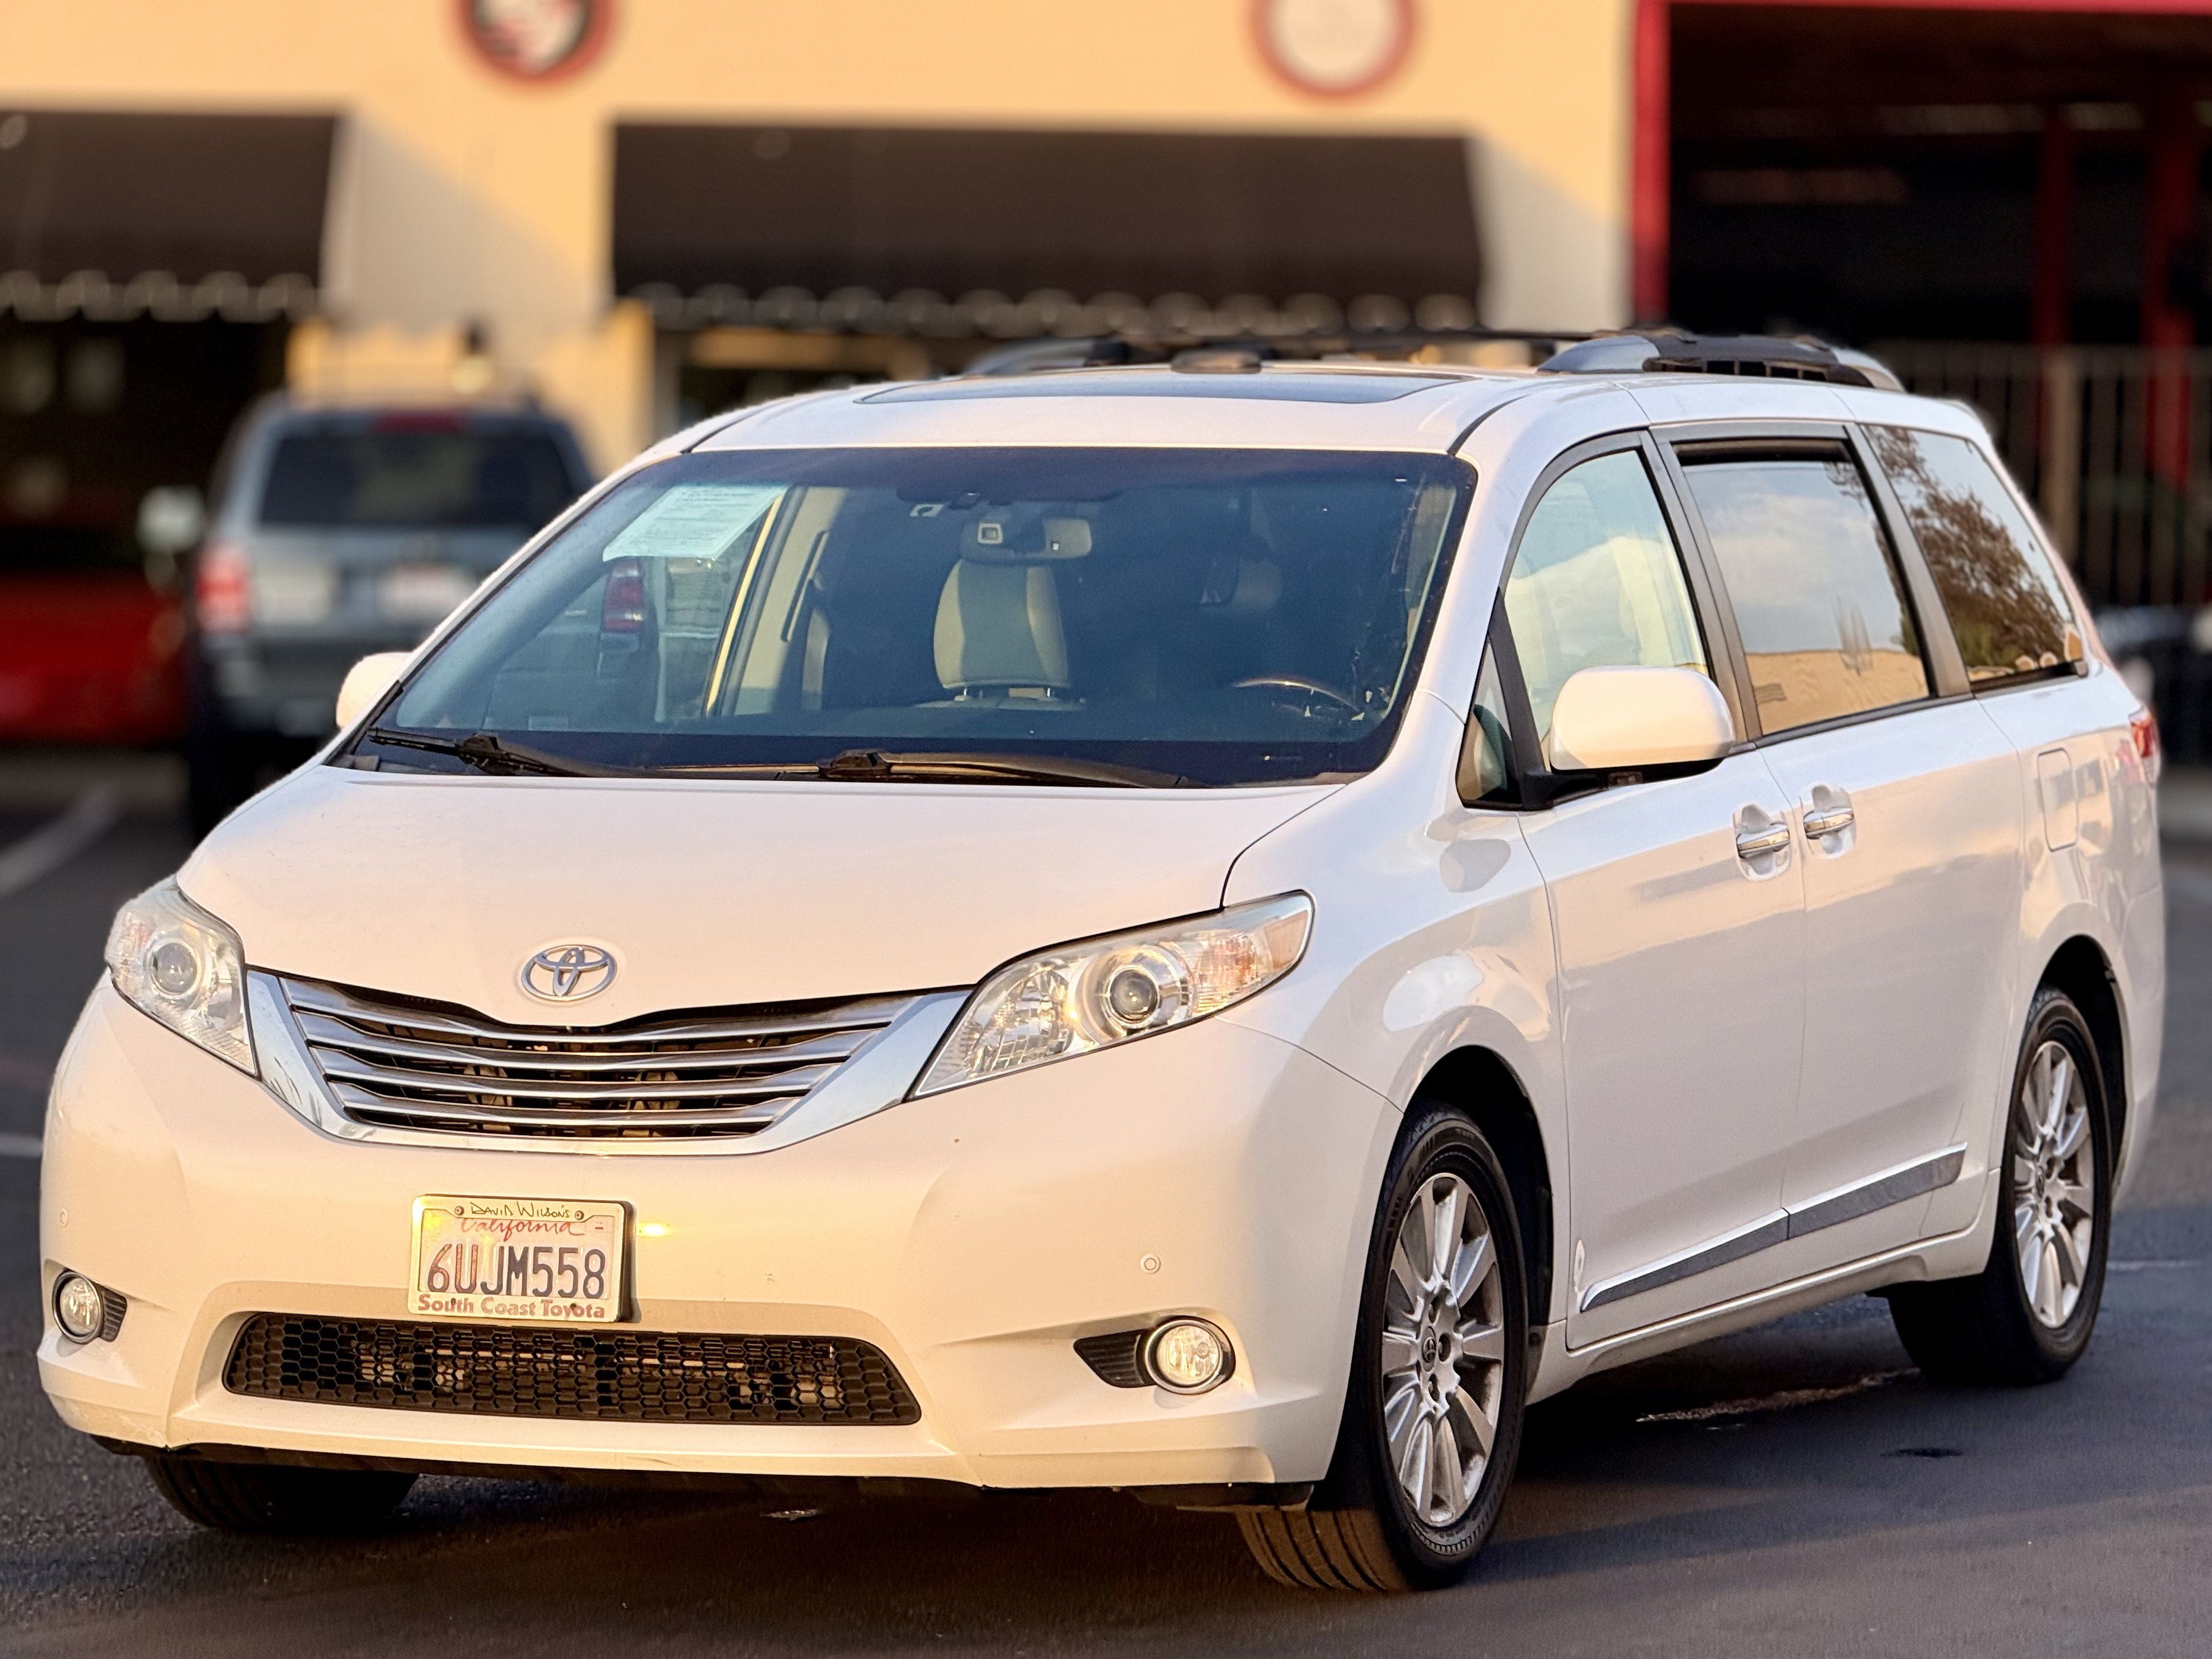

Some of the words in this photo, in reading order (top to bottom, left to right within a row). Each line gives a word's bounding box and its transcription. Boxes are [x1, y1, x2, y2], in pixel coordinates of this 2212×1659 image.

[460, 1219, 584, 1242] California
[427, 1244, 606, 1299] 6UJM558
[417, 1293, 474, 1313] South
[480, 1296, 536, 1316] Coast
[541, 1298, 605, 1321] Toyota
